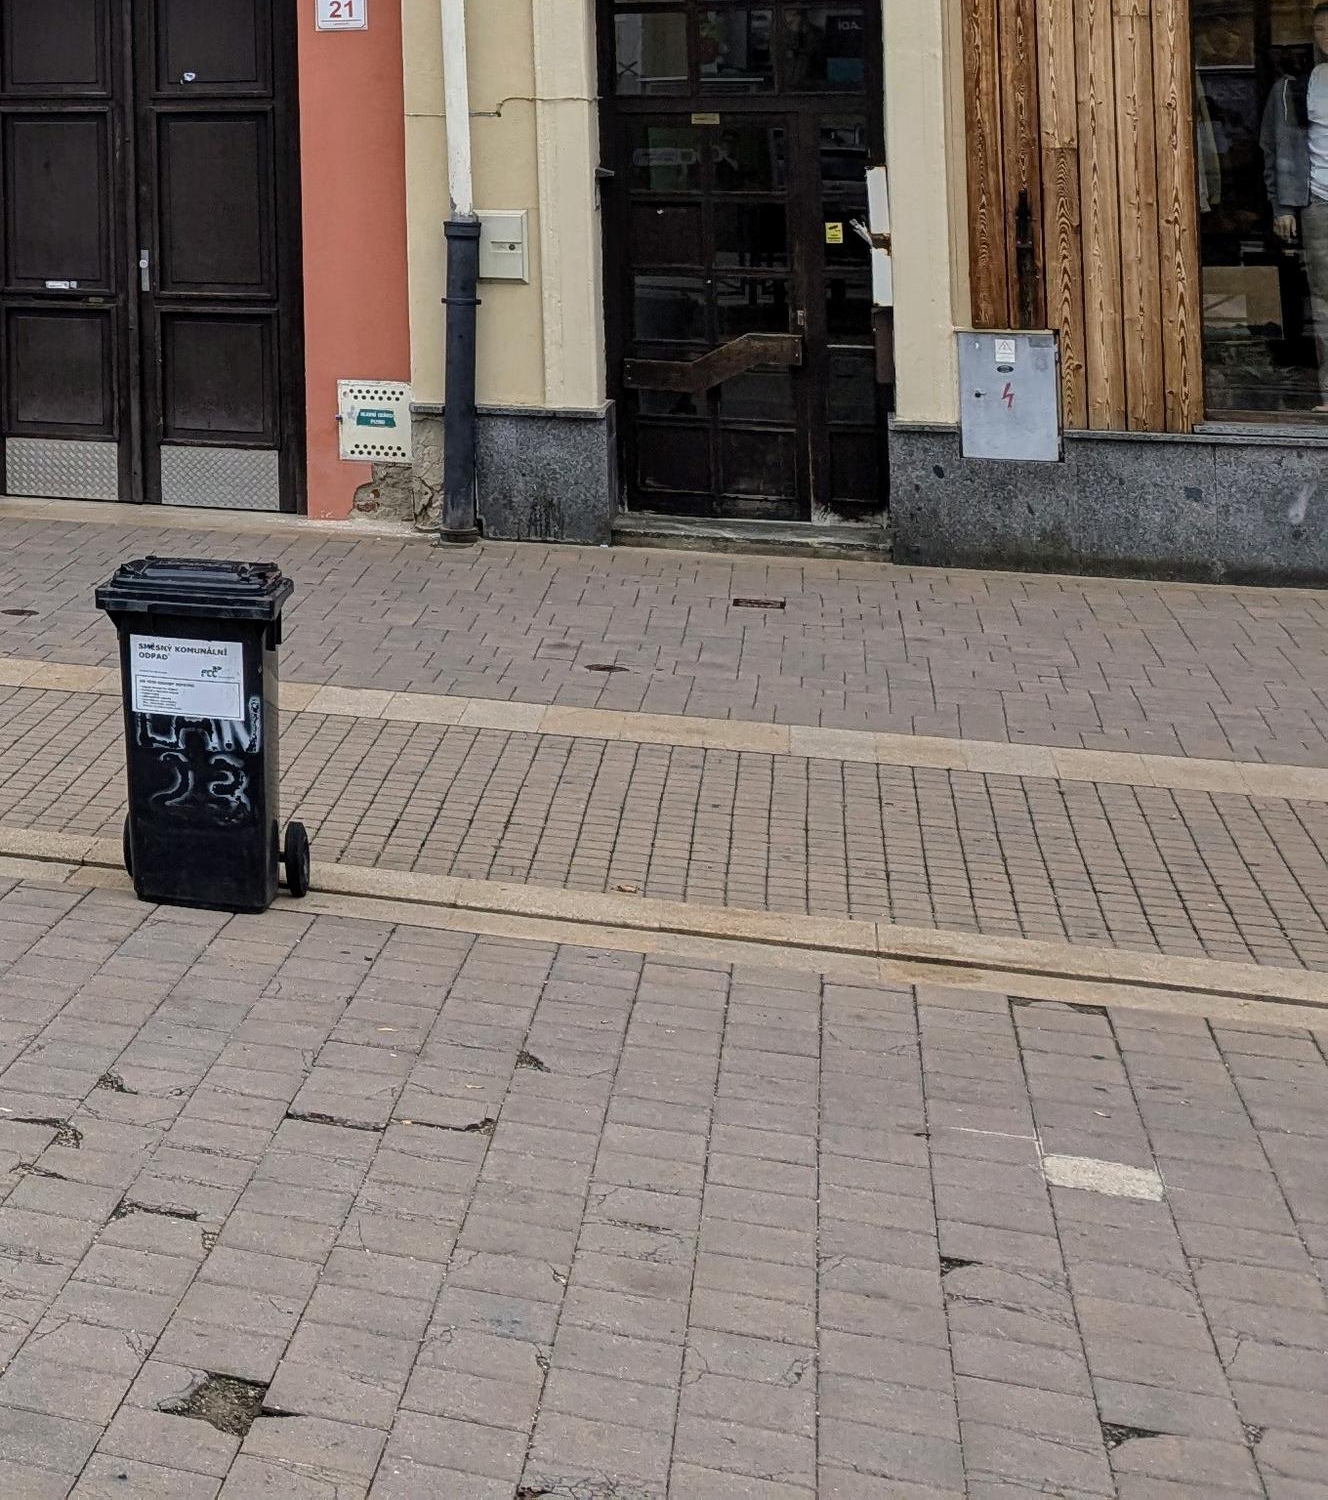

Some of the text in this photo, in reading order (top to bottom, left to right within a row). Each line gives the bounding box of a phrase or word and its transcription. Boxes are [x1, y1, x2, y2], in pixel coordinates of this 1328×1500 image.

[329, 0, 353, 18] 21
[139, 643, 228, 656] SMĚSNÝ KOMUNÁLNÍ
[139, 652, 168, 660] ODPAD
